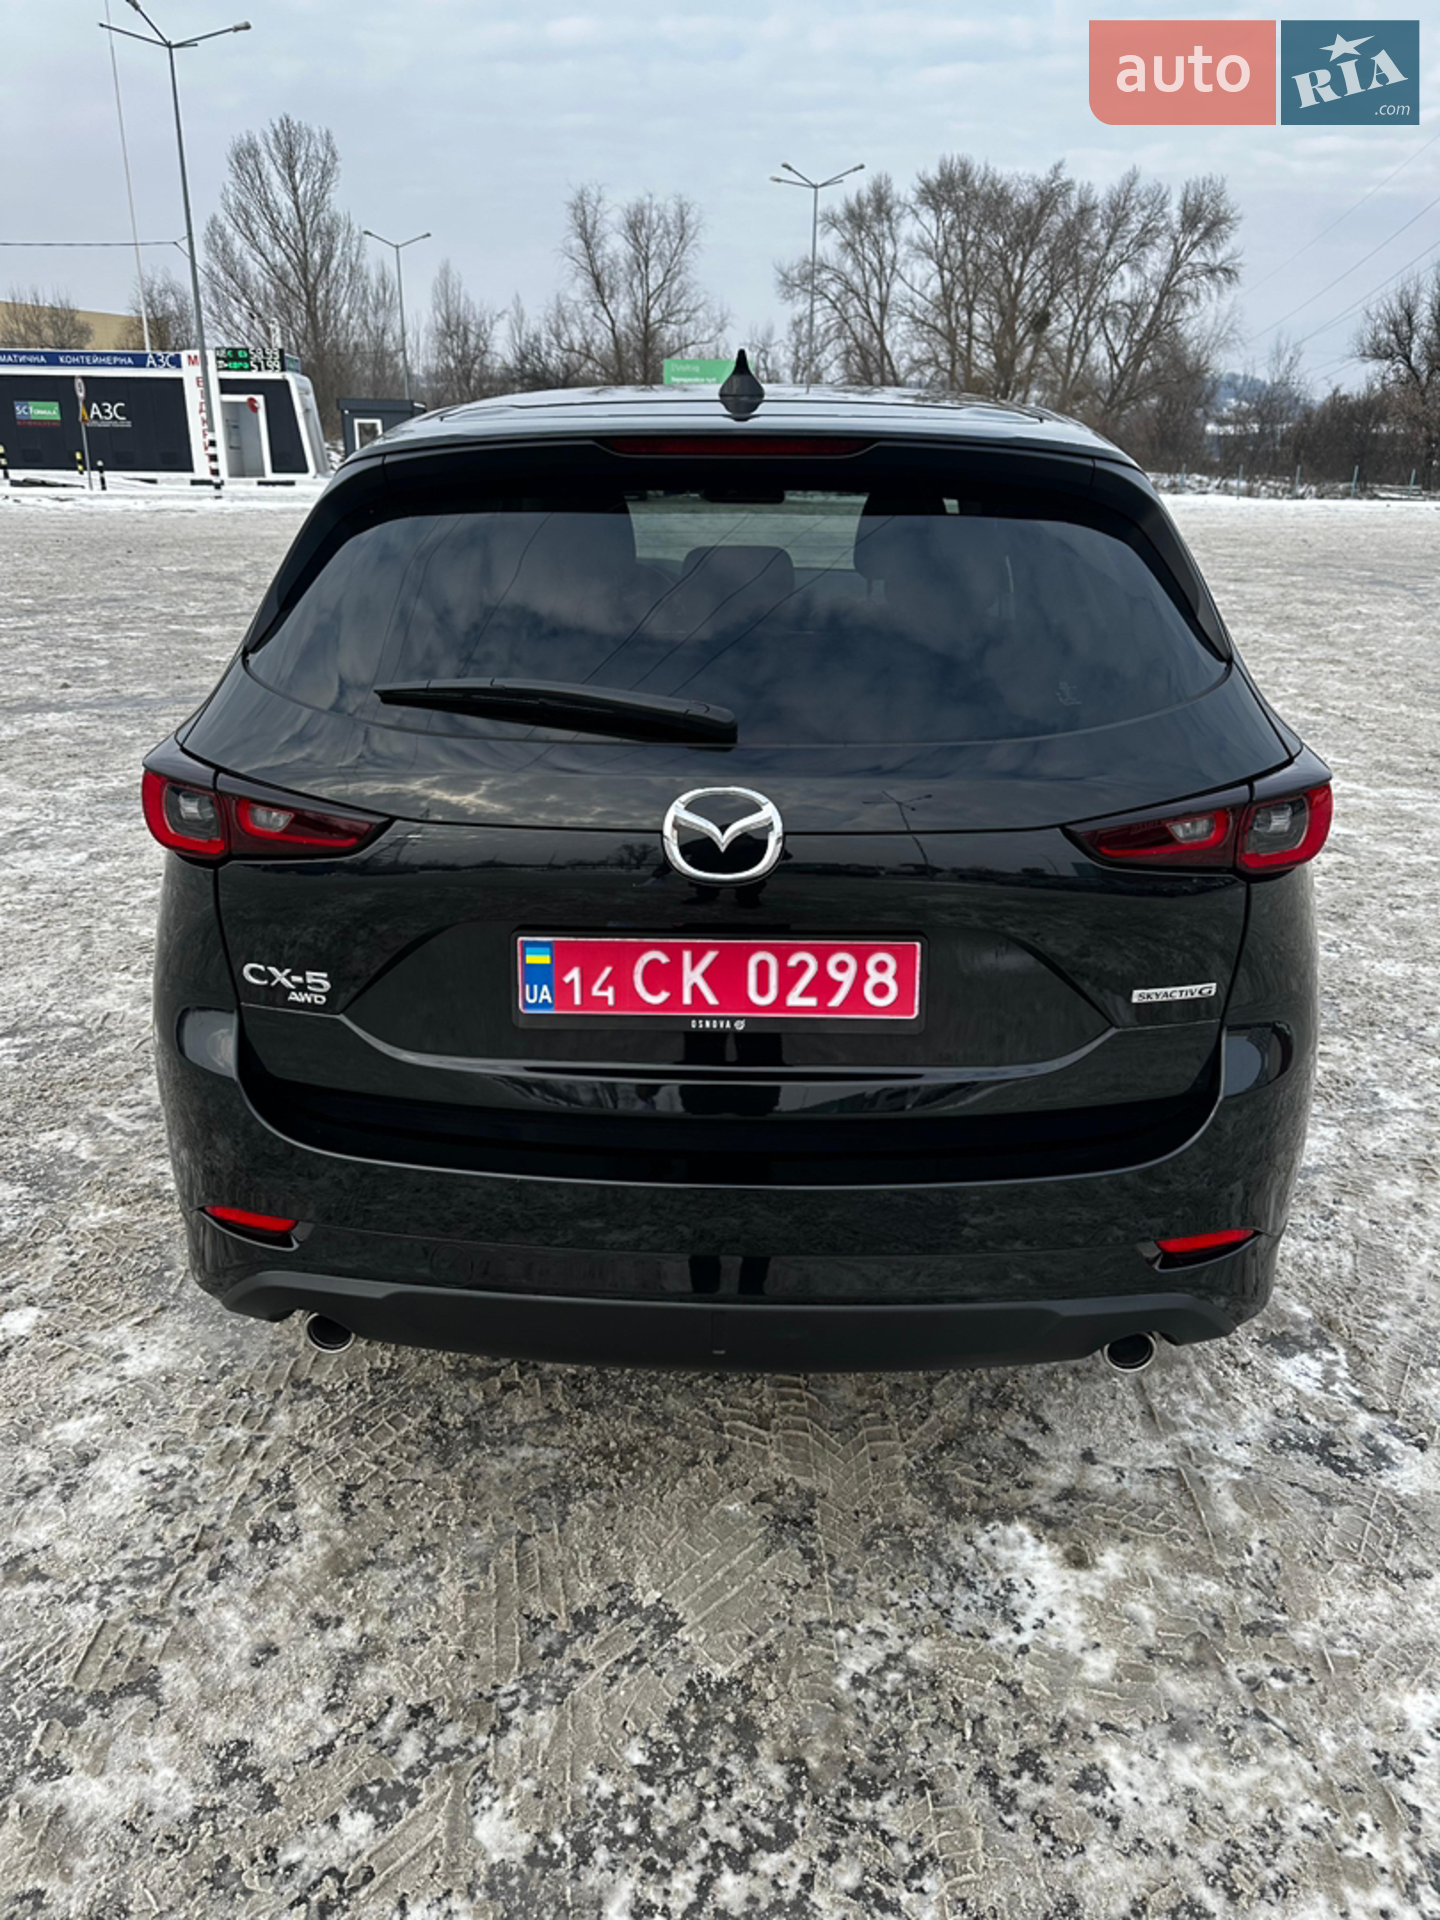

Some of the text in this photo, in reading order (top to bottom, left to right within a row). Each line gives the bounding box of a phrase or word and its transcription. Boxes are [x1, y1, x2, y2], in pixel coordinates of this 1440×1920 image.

[58, 353, 134, 366] КОНТЕЙНЕРНА
[146, 352, 177, 369] АЗС
[90, 402, 127, 420] АЗС
[242, 963, 331, 992] CX-5
[562, 950, 898, 1007] 14 CK 0298
[287, 992, 327, 1005] AWD
[526, 984, 552, 1003] UA
[691, 1019, 731, 1029] OSNOVA
